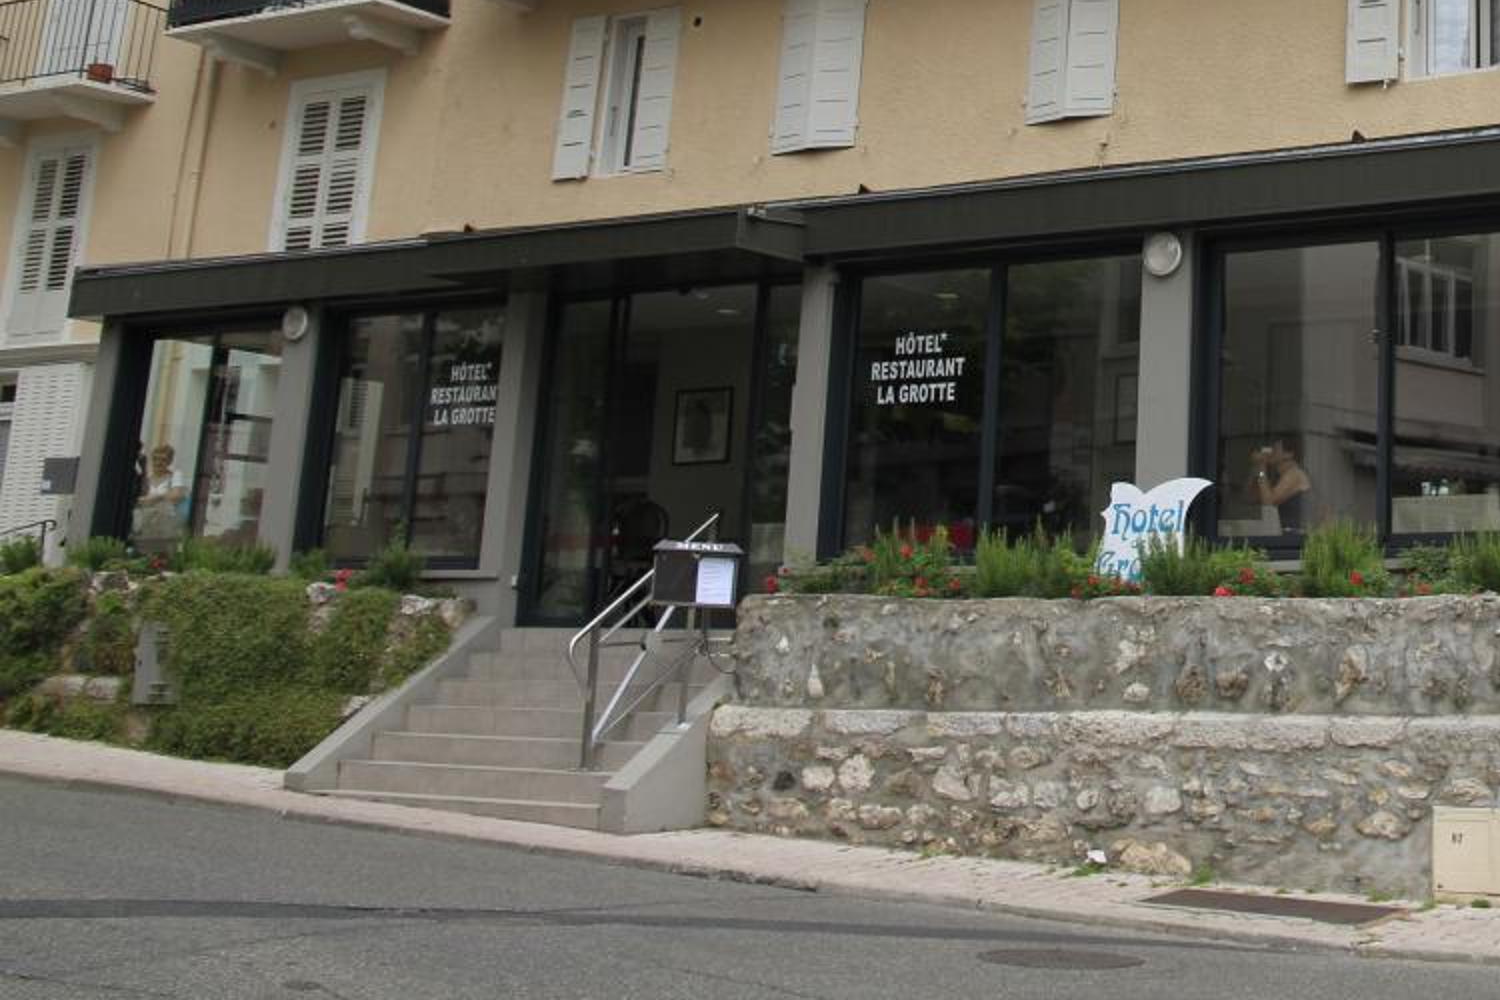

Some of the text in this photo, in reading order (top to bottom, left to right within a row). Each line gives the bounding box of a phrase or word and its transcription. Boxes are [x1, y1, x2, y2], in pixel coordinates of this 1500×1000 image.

[872, 357, 966, 381] RESTAURANT
[430, 385, 497, 405] RESTAURAN
[877, 382, 957, 405] LA GROTTE
[433, 406, 496, 425] LA GROTTE
